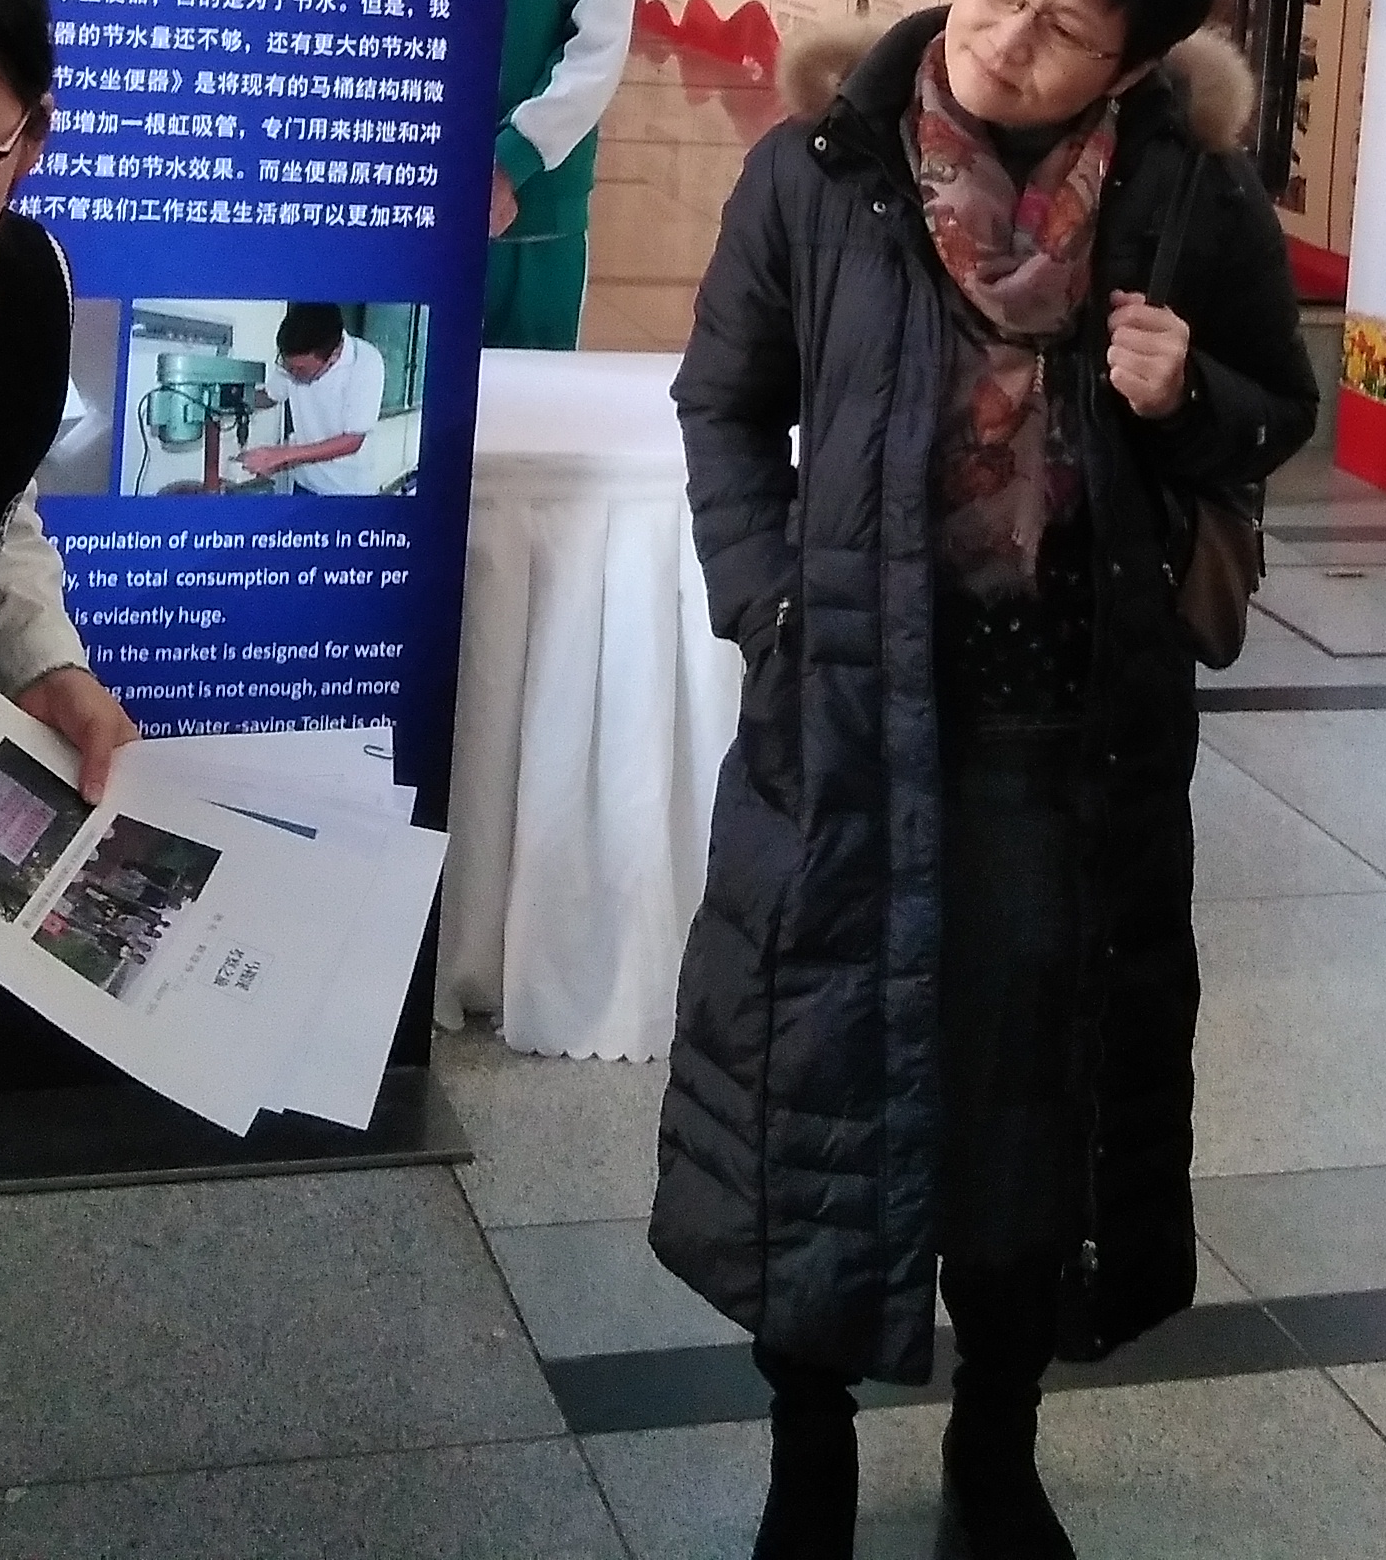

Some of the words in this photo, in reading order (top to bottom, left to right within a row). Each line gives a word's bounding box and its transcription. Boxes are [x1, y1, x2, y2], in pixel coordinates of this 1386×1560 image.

[49, 21, 447, 61] 器的节水量还不够，还有更大的节水潜
[65, 531, 162, 554] population
[168, 530, 188, 550] of
[194, 530, 245, 549] urban
[251, 530, 330, 549] residents
[336, 530, 351, 548] in
[357, 529, 412, 550] China,
[88, 570, 118, 588] the
[126, 569, 168, 588] total
[176, 568, 290, 591] consumption
[298, 566, 316, 585] of
[324, 568, 373, 586] water
[380, 570, 409, 589] per
[75, 607, 88, 626] is
[92, 606, 175, 628] evidently
[178, 605, 227, 626] huge.
[97, 644, 113, 662] in
[120, 643, 149, 662] the
[155, 642, 217, 662] market
[223, 642, 236, 661] is
[241, 641, 320, 665] designed
[324, 640, 349, 659] for
[355, 641, 403, 659] water
[125, 681, 195, 700] amount
[199, 680, 212, 699] is
[215, 680, 244, 698] not
[248, 679, 317, 701] enough,
[321, 677, 353, 697] and
[356, 679, 400, 696] more
[177, 717, 230, 736] Water
[301, 715, 347, 732] Toilet
[352, 715, 365, 730] is
